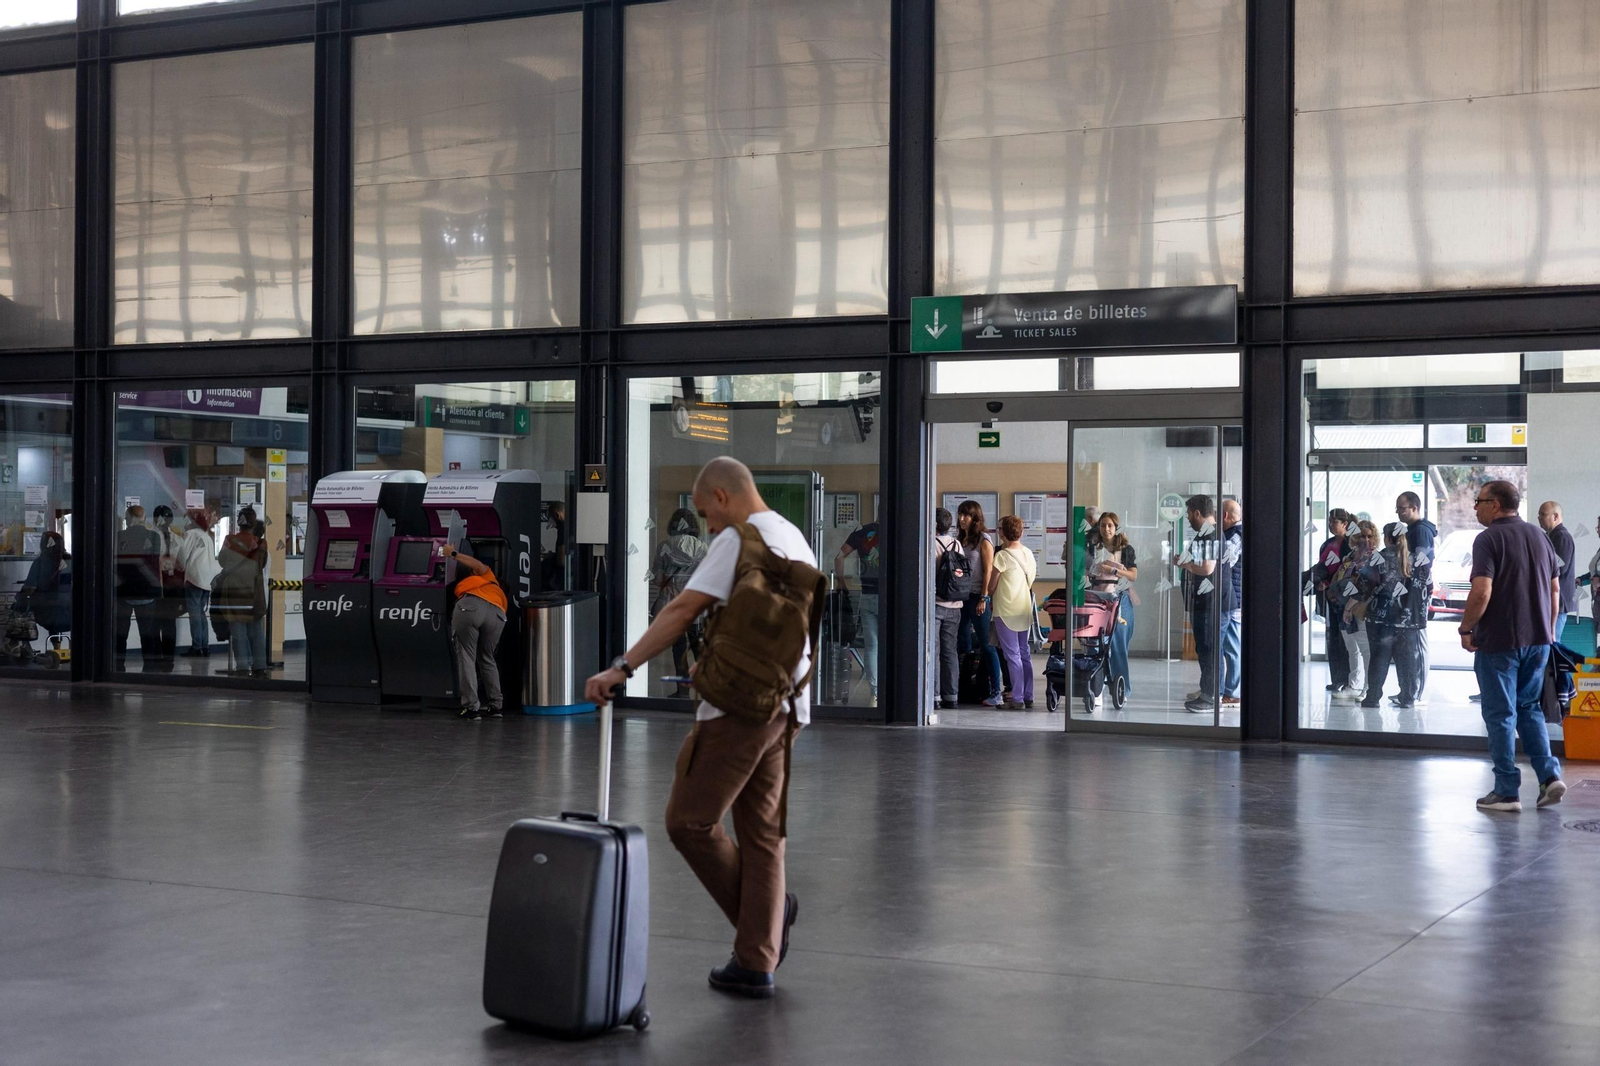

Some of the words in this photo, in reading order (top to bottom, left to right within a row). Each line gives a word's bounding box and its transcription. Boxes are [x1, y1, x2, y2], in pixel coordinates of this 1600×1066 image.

[1013, 307, 1058, 322] Venta
[1063, 305, 1083, 320] de
[1089, 303, 1147, 320] billetes
[1013, 328, 1046, 338] TICKET
[1049, 327, 1077, 337] SALES
[119, 391, 138, 400] service
[206, 398, 235, 408] Information
[449, 405, 477, 418] Atención
[477, 407, 484, 418] al
[485, 408, 505, 420] cliente
[513, 533, 531, 608] ren
[308, 594, 353, 617] renfe
[379, 600, 433, 628] renfe
